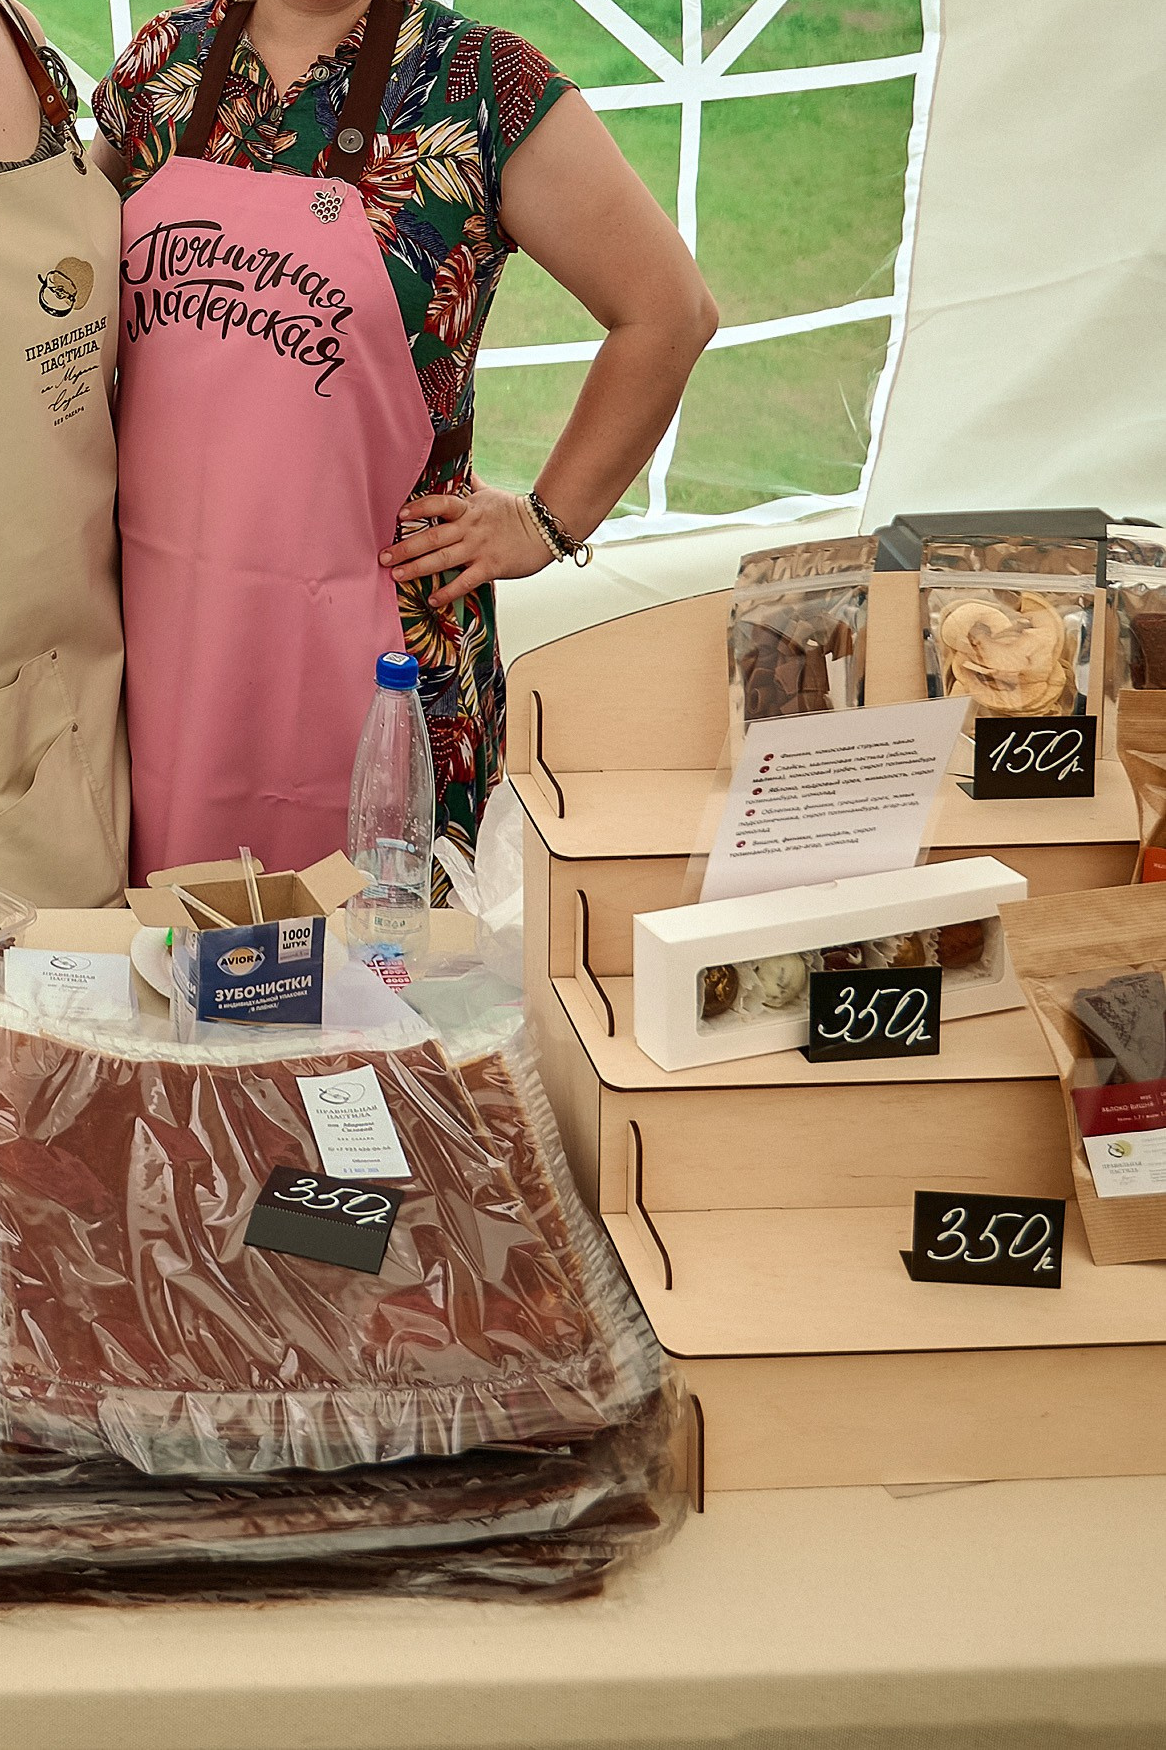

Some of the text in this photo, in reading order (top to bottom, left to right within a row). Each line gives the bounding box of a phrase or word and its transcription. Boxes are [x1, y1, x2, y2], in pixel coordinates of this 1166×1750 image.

[120, 219, 353, 336] Пряничная
[24, 316, 108, 362] ПРАВИЛЬНАЯ
[40, 339, 101, 375] ПАСТИЛА
[282, 927, 311, 942] 1000
[282, 939, 308, 950] ШТУК
[220, 953, 262, 966] AVIORA
[214, 974, 312, 1002] ЗУБОЧИСТКИ
[223, 995, 278, 1009] ИНДИВИДУАЛЬНОЙ
[279, 990, 308, 1000] УПАКОВКЕ
[316, 1104, 378, 1114] ПРАВИЛЬНАЯ
[326, 1112, 371, 1120] ПАСТИЛА
